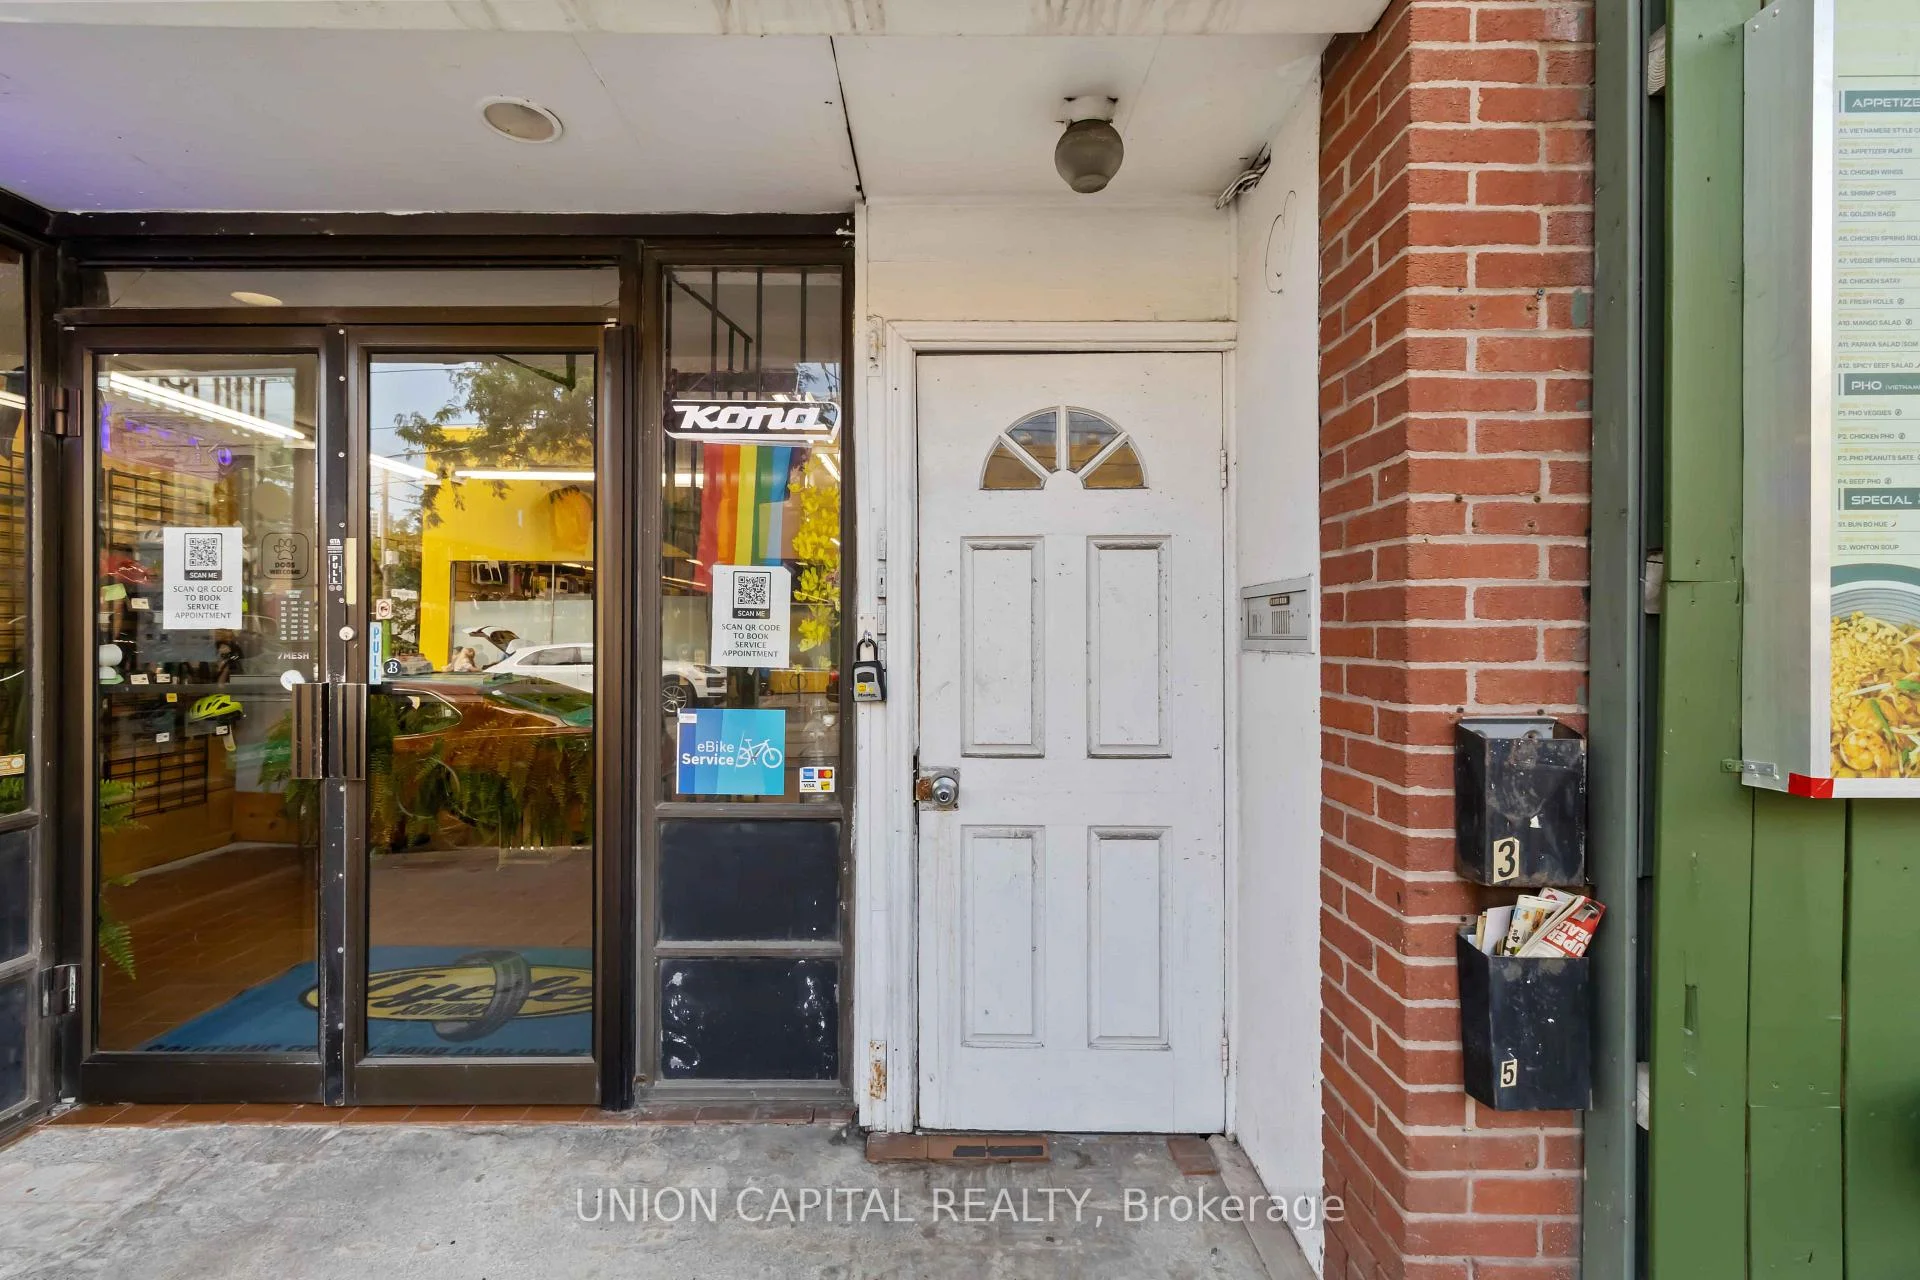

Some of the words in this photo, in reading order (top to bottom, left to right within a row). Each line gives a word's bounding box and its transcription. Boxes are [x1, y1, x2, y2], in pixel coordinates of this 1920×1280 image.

[1852, 381, 1882, 390] PHO
[1851, 496, 1912, 504] SPECIAL
[697, 740, 735, 753] eBike
[682, 754, 735, 766] Service
[1498, 840, 1516, 878] 3
[1502, 1061, 1515, 1085] 5
